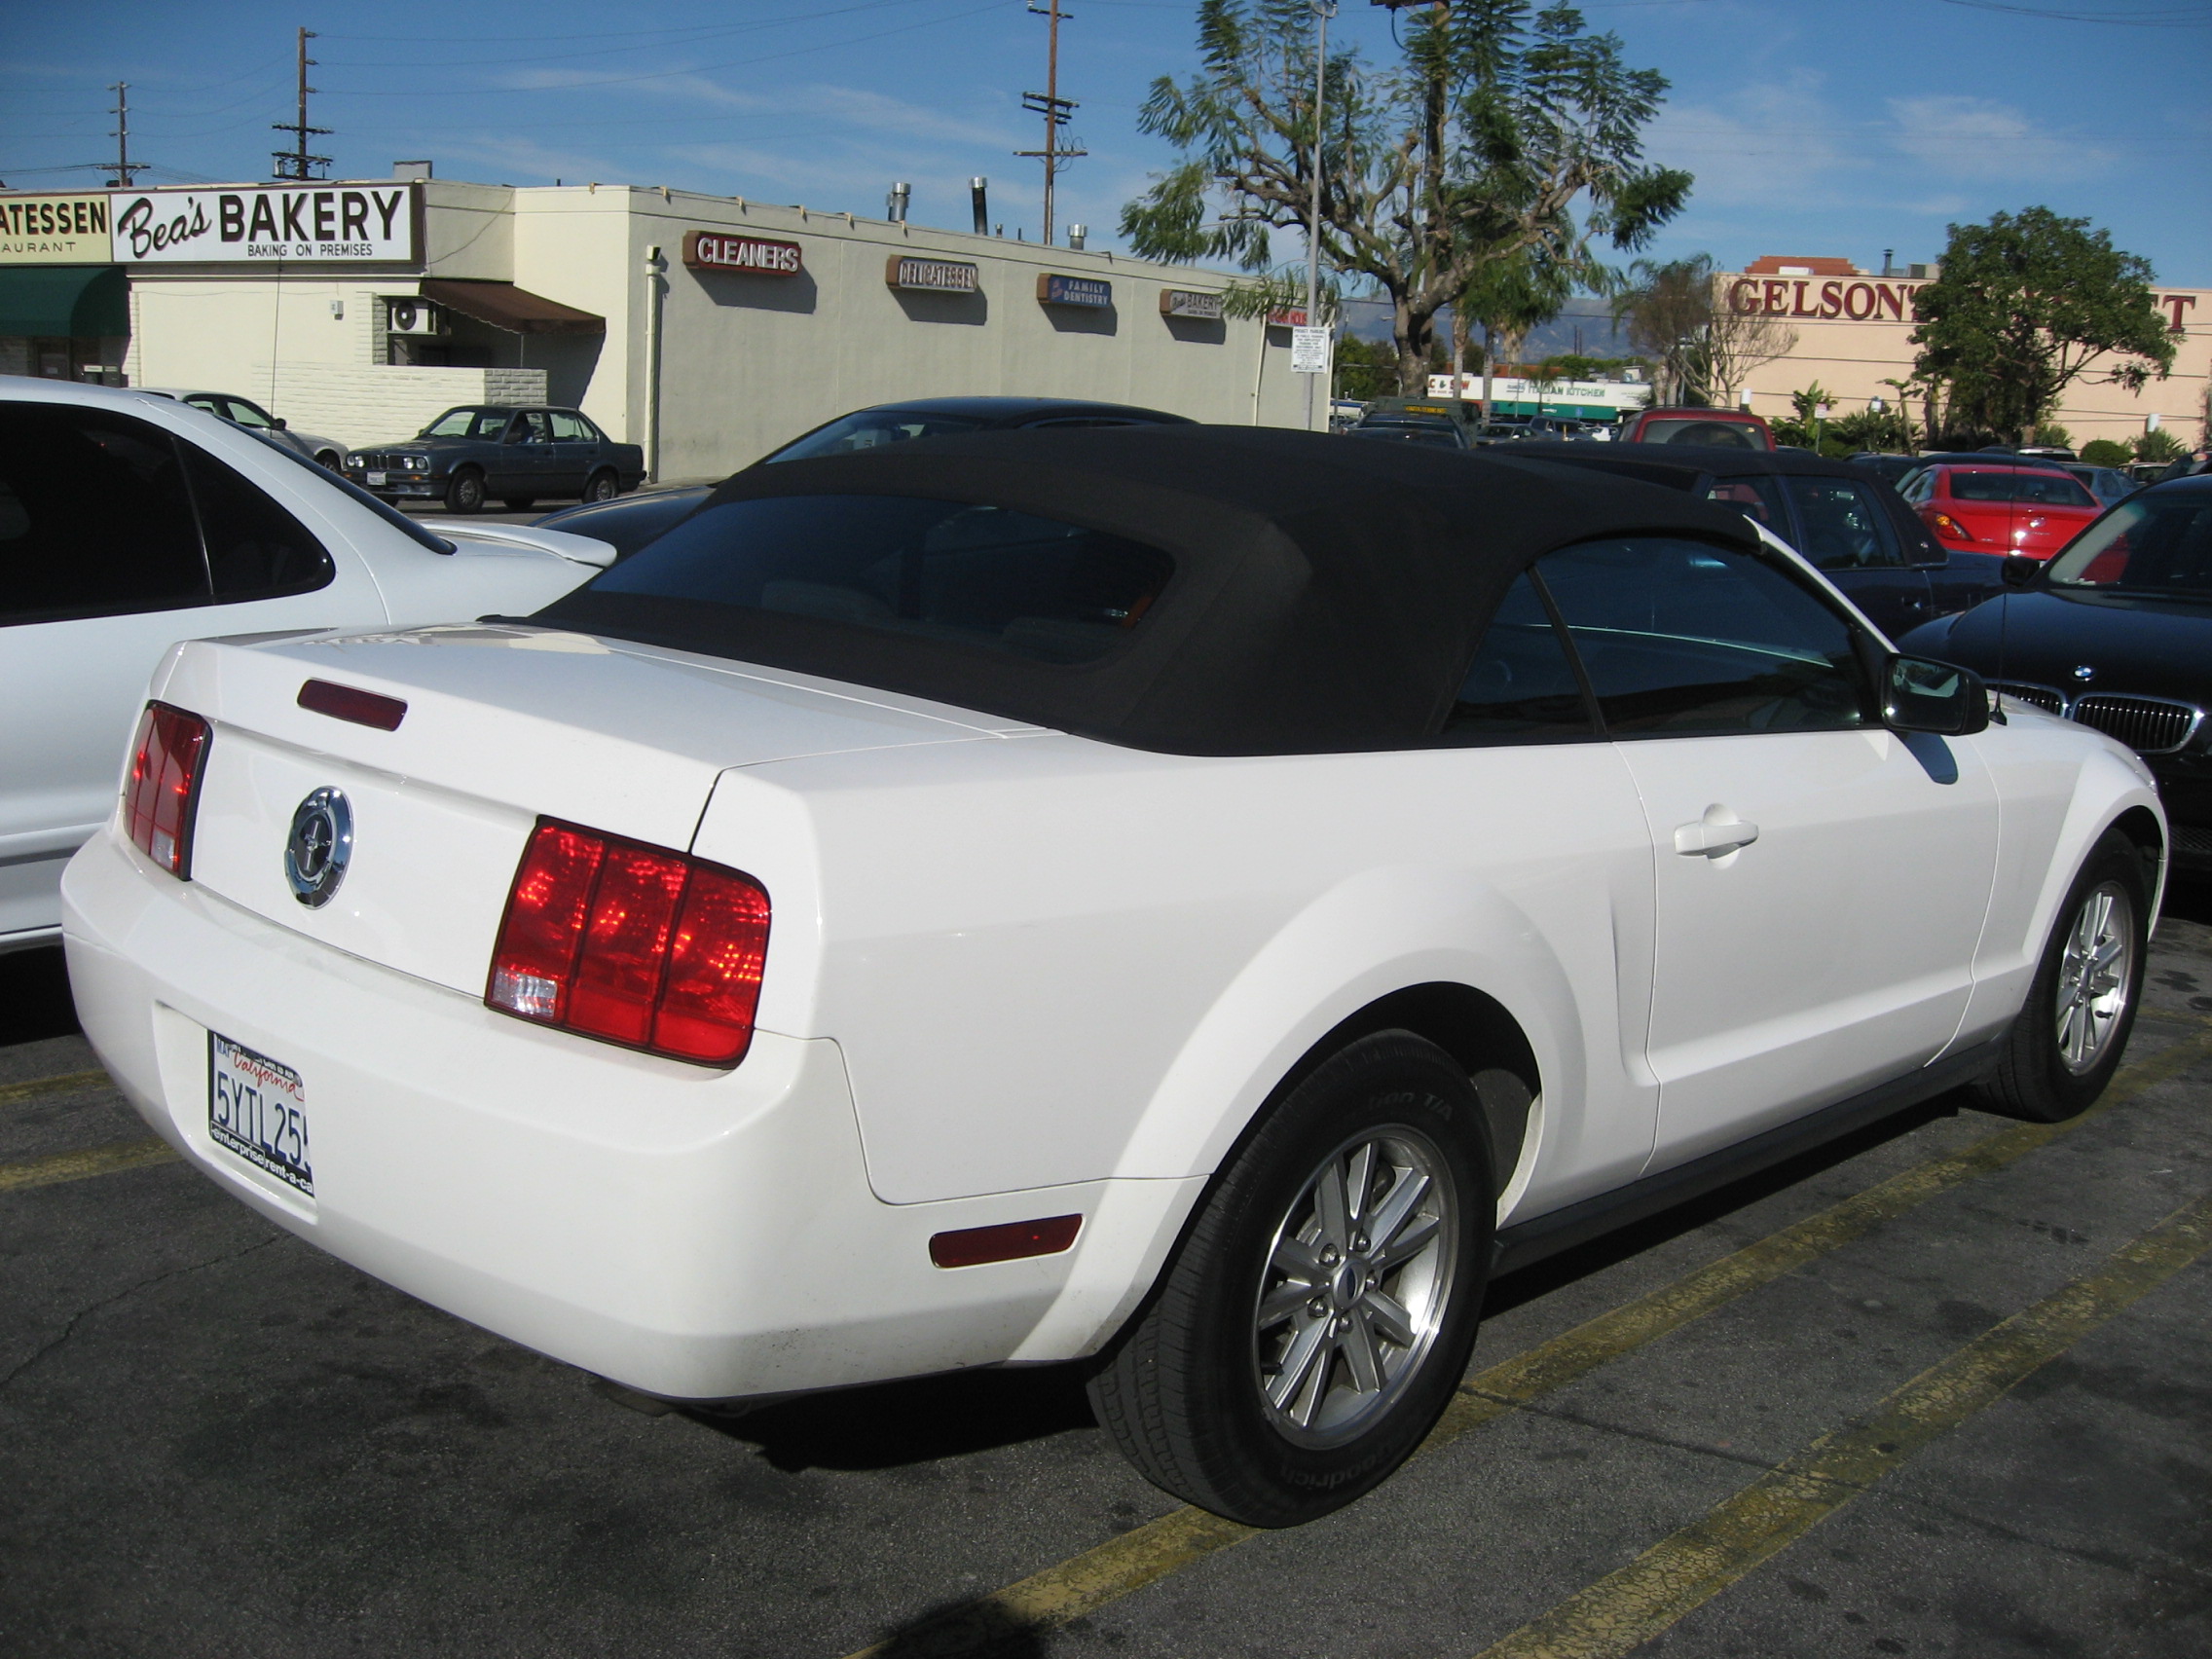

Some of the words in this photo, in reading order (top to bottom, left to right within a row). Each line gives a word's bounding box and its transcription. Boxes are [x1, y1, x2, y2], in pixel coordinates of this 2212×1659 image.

[117, 197, 212, 259] Bea's
[219, 190, 403, 242] BAKERY
[247, 242, 287, 257] BAKING
[296, 243, 313, 257] ON
[319, 242, 373, 256] PREMISES
[697, 237, 799, 273] CLEANERS
[901, 262, 977, 289] DELICATESSEN
[1068, 279, 1105, 294] FAMILY
[1063, 291, 1108, 306] DENTISTRY
[1566, 387, 1605, 397] KITCHEN
[234, 1051, 305, 1102] California
[211, 1127, 264, 1165] enterprise
